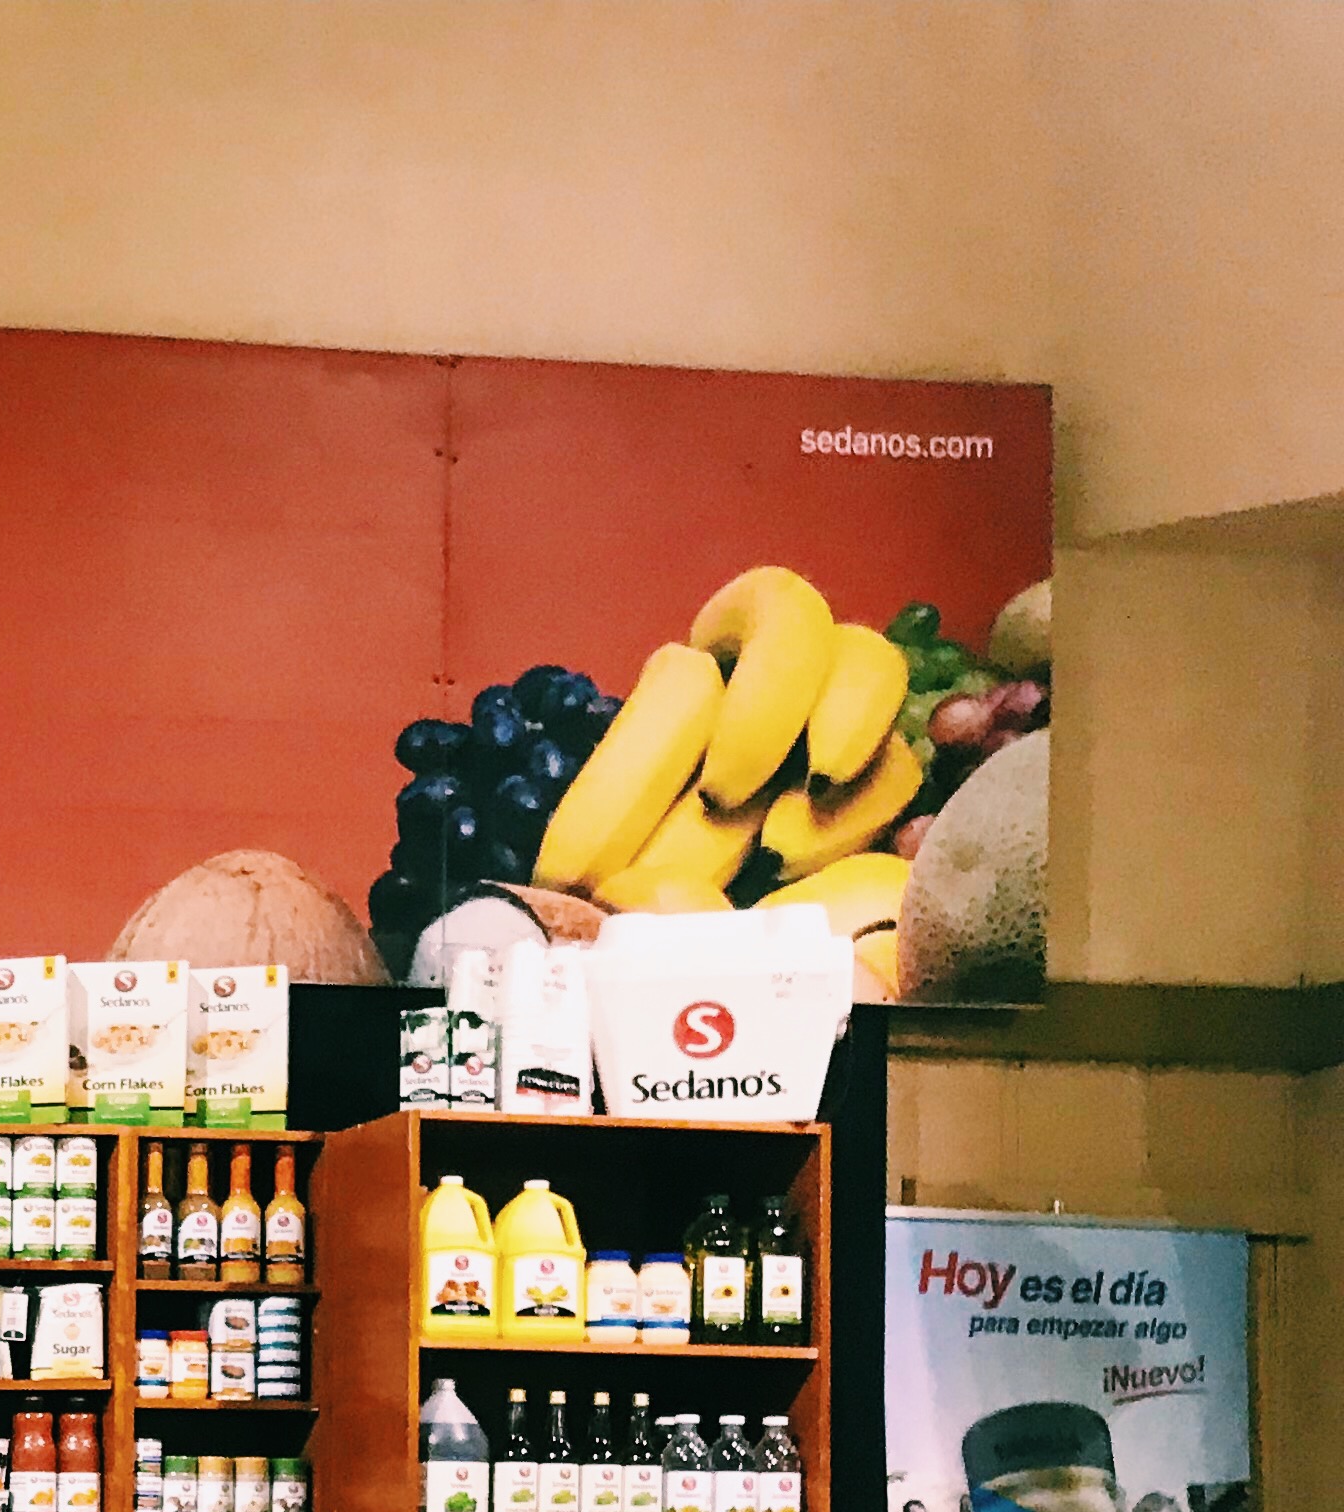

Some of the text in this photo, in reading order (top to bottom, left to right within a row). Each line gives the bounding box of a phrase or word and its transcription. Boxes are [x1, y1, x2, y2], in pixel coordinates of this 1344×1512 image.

[800, 424, 994, 459] sedanos.com
[0, 1075, 45, 1089] Flakes
[82, 1078, 164, 1091] Corn Flakes
[184, 1082, 265, 1097] Corn Flakes
[631, 1069, 783, 1104] Sedano's
[918, 1249, 1167, 1308] Hoy es el día
[968, 1315, 1188, 1344] para empezar algo
[52, 1342, 91, 1357] Sugar
[1102, 1355, 1207, 1393] ¡Nuevo!
